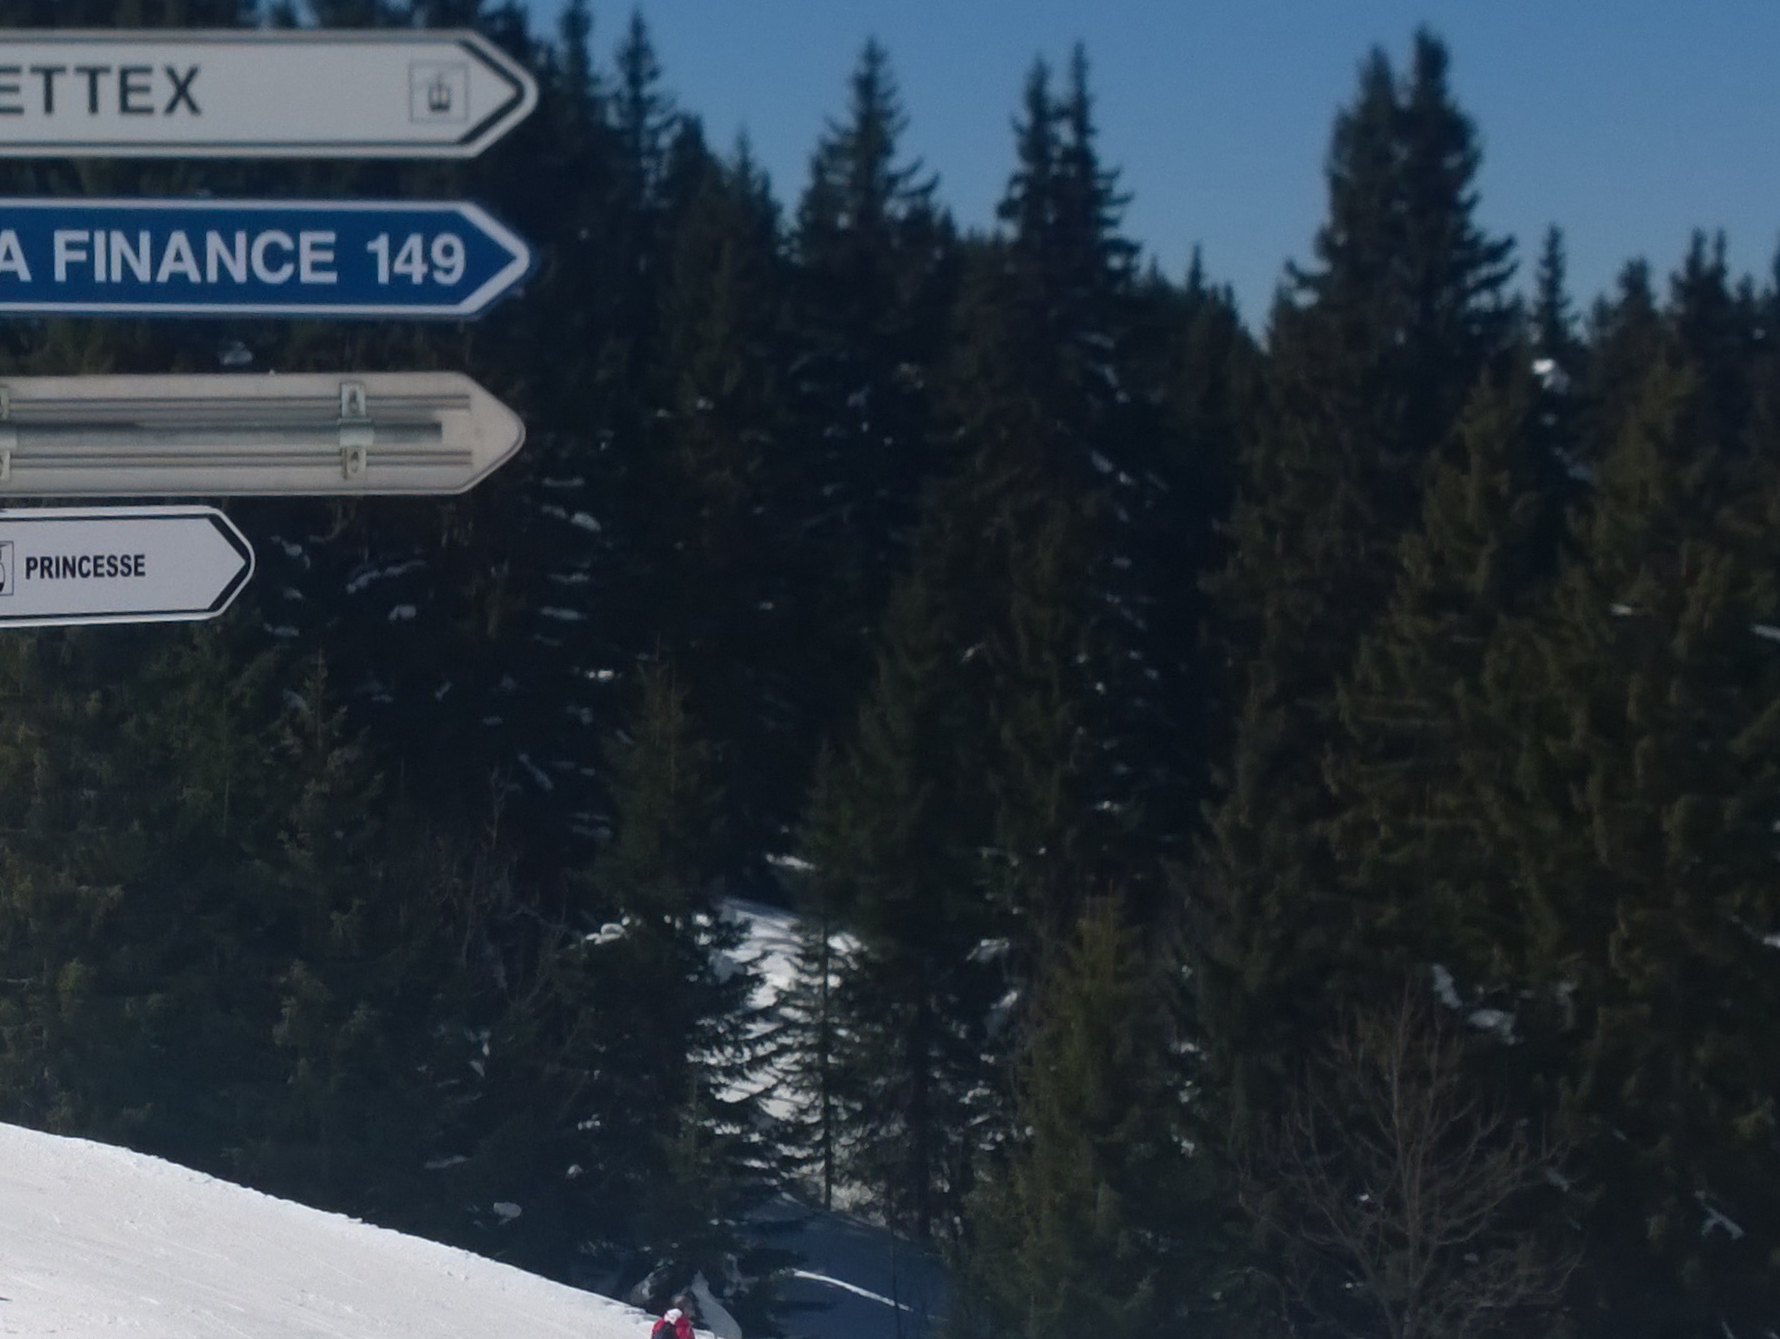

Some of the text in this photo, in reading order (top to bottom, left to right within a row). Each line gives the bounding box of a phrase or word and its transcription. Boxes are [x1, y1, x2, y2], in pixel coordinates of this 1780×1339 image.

[53, 230, 337, 285] FINANCE
[366, 233, 466, 285] 149
[25, 554, 146, 580] PRINCESSE
